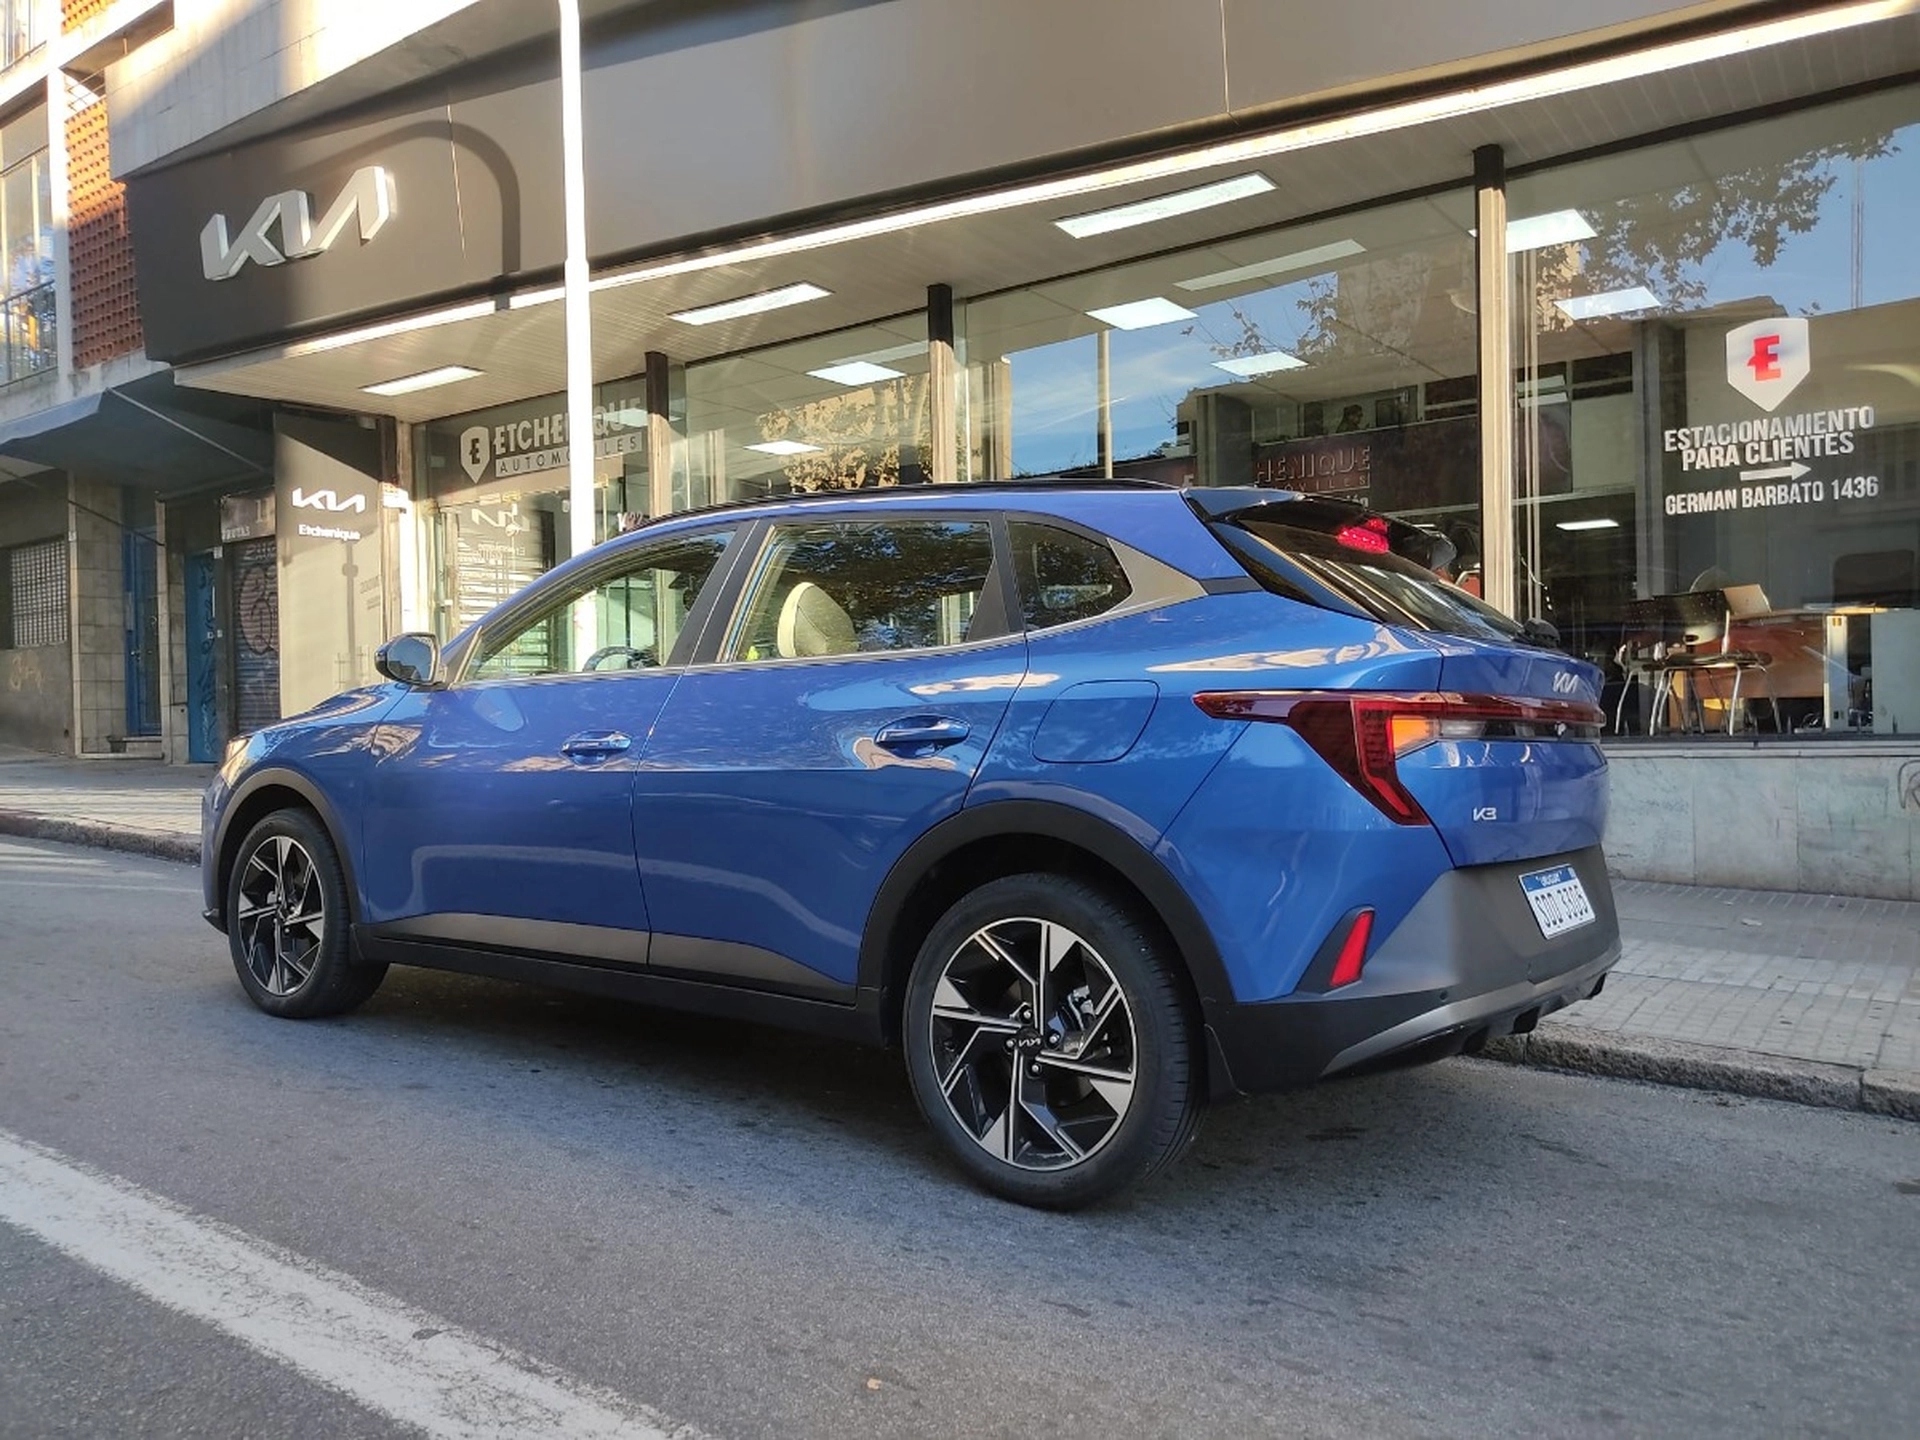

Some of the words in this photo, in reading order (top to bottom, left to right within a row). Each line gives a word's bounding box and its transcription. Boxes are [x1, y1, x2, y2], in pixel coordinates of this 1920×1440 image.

[200, 165, 390, 281] KIA
[1664, 406, 1875, 452] ESTACIONAMIENTO
[1682, 445, 1741, 471] PARA
[1745, 431, 1855, 465] CLIENTES
[292, 487, 366, 513] KIA
[1665, 488, 1737, 515] GERMAN
[1741, 481, 1824, 508] BARBATO
[1831, 475, 1879, 500] 1436
[298, 524, 361, 542] Etchenique
[1473, 807, 1497, 821] K3
